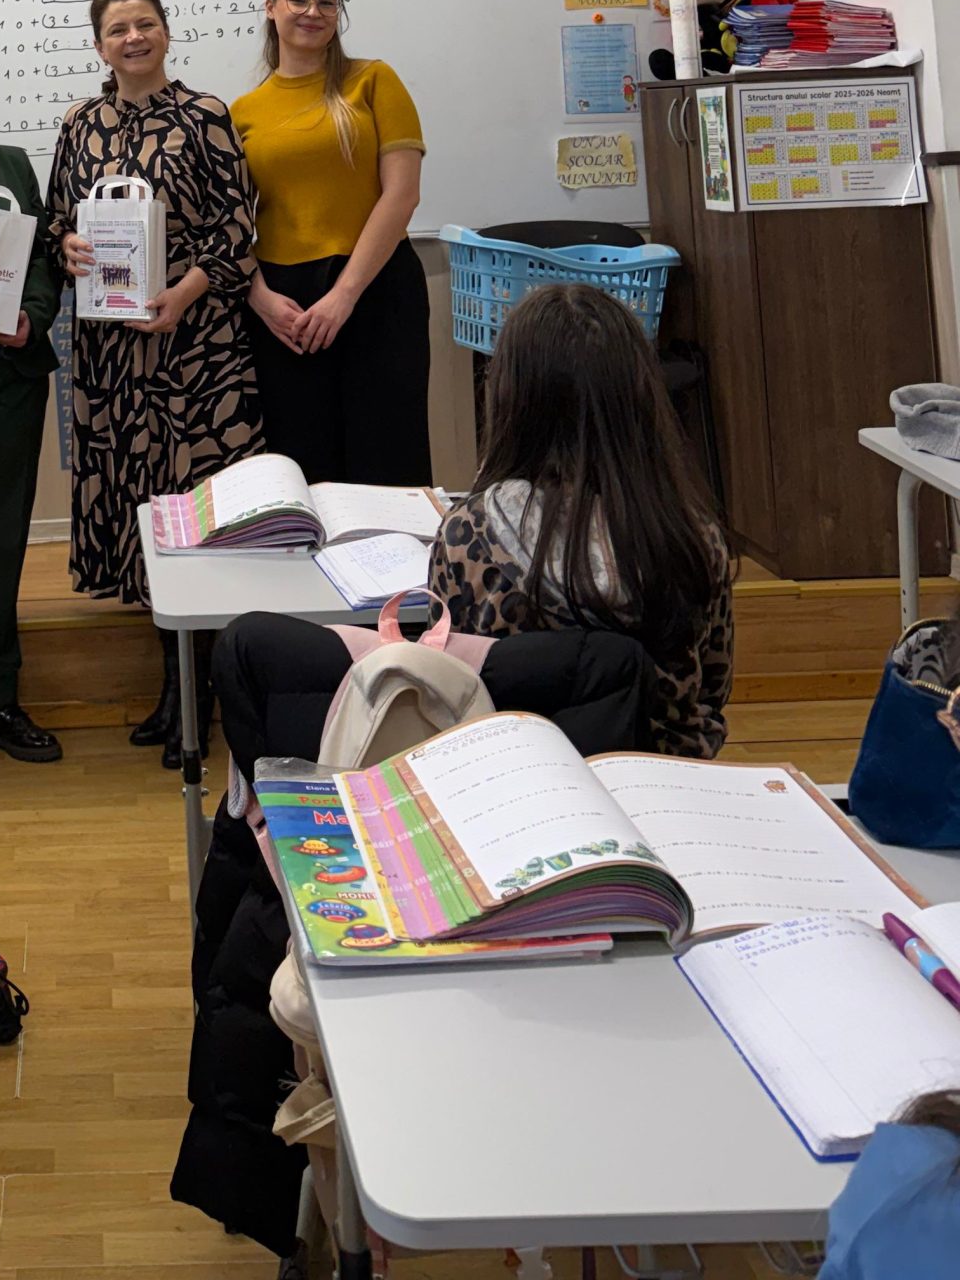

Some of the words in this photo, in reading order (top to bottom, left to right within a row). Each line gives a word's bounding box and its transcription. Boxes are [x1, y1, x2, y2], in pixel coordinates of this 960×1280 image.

[748, 94, 783, 102] Structura
[786, 92, 808, 100] anului
[835, 90, 874, 98] 2025-2026
[567, 155, 625, 170] ȘCOLAR
[306, 784, 329, 792] Elena
[503, 887, 518, 898] 100
